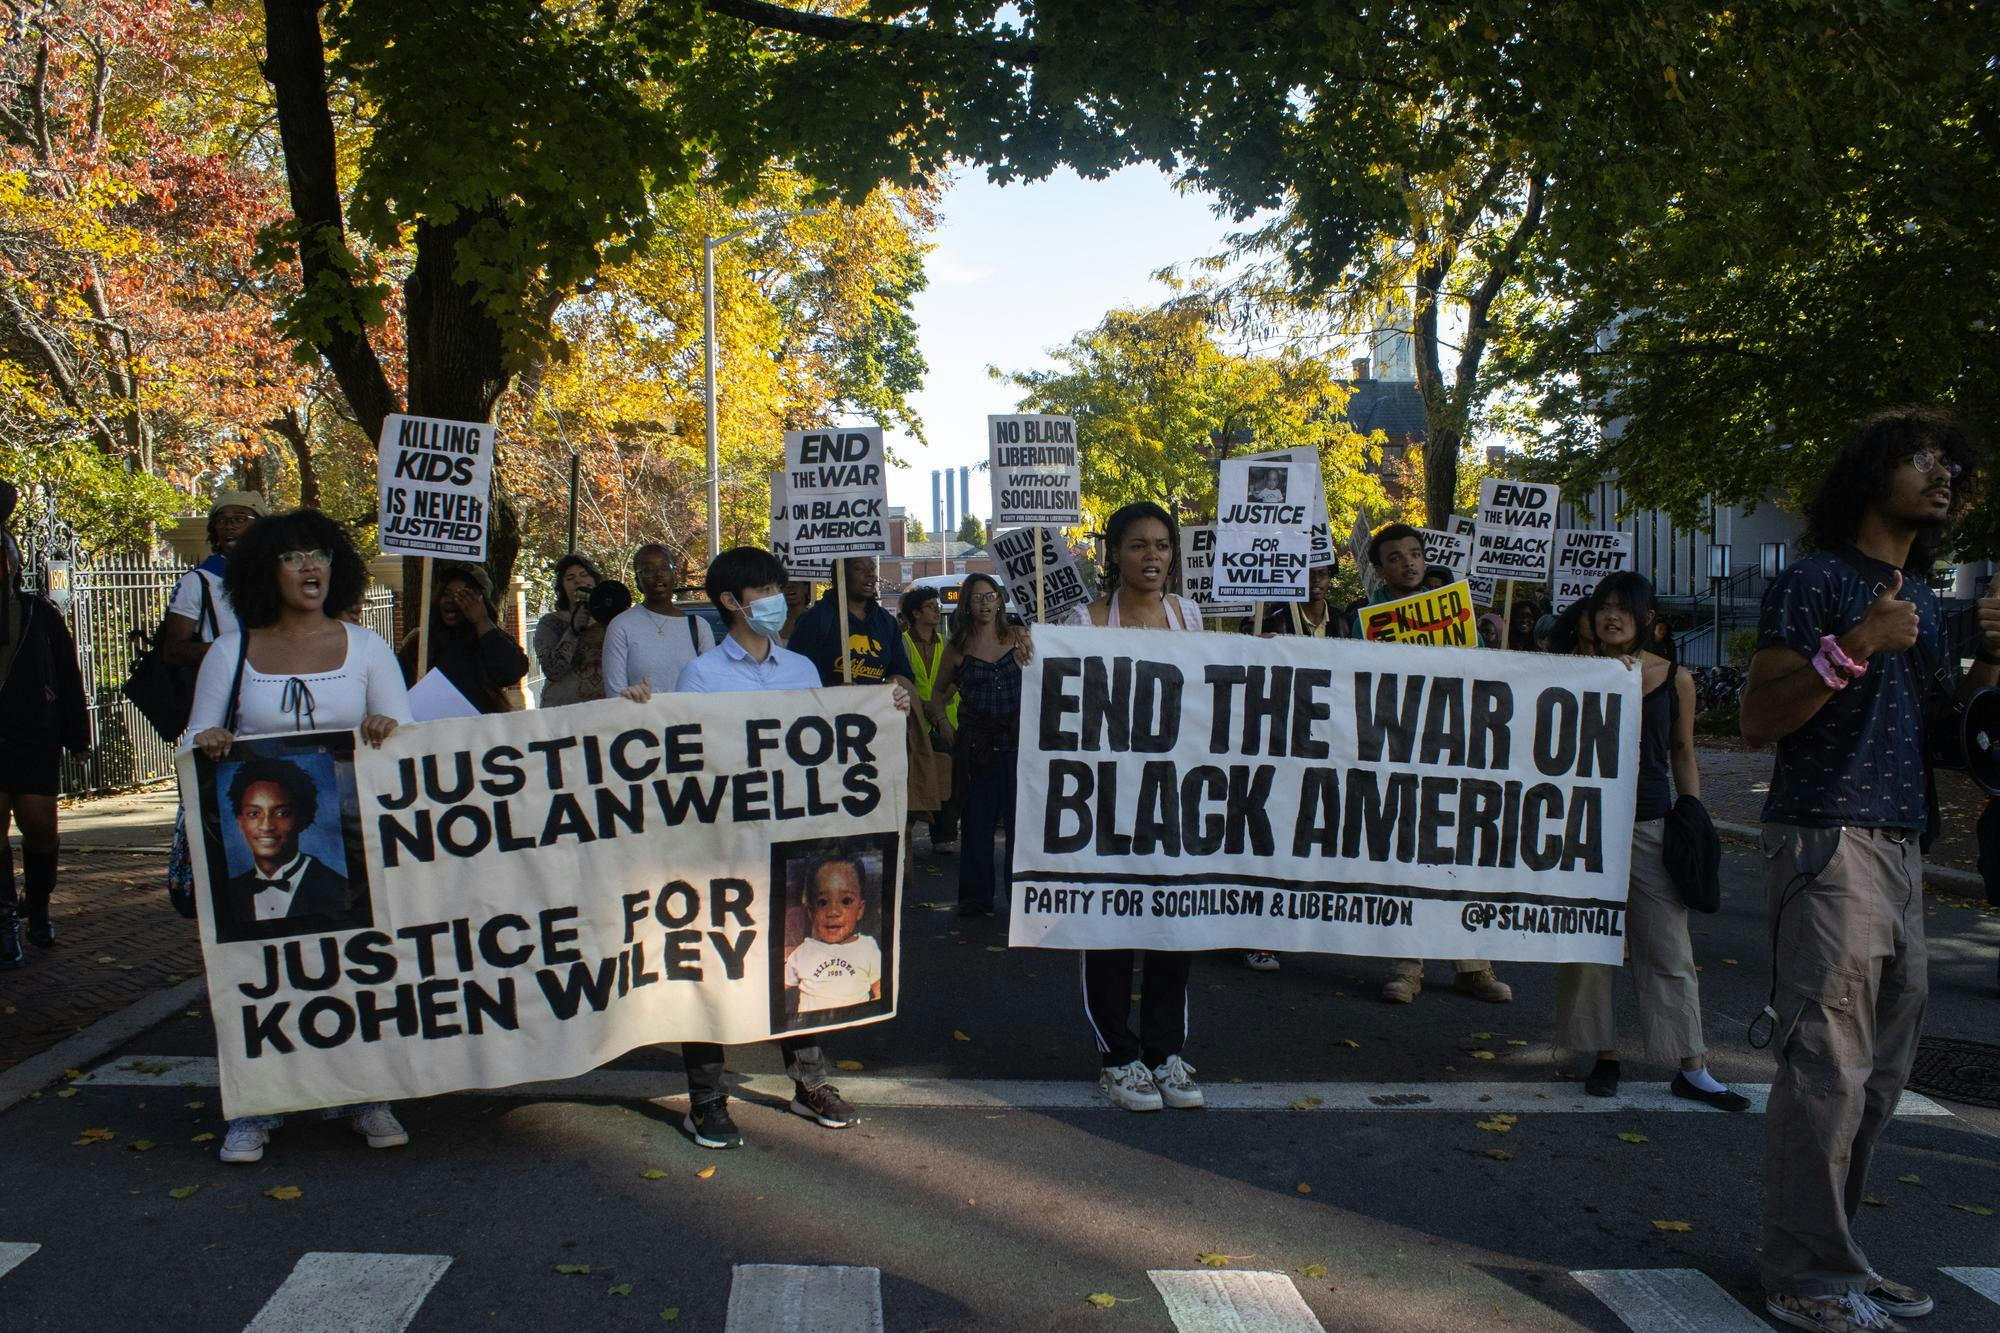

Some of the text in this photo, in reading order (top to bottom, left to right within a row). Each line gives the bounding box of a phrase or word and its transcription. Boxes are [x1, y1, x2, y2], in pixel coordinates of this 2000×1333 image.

[398, 420, 480, 455] KILLING
[996, 421, 1074, 444] NO BLACK
[800, 433, 870, 464] END
[997, 447, 1075, 467] LIBERATION
[394, 450, 475, 486] KIDS
[792, 464, 880, 488] THE WAR
[1009, 474, 1071, 487] WITHOUT
[387, 487, 482, 523] IS NEVER
[1001, 490, 1077, 509] SOCIALISM
[1492, 485, 1547, 509] END
[793, 504, 808, 520] ON
[811, 498, 883, 520] BLACK
[1221, 505, 1306, 524] JUSTICE
[1485, 509, 1552, 528] THE WAR
[385, 516, 482, 541] JUSTIFIED
[795, 520, 882, 540] AMERICA
[1192, 530, 1217, 551] EN
[1252, 538, 1280, 551] FOR
[1424, 532, 1456, 548] NITE
[1480, 536, 1550, 554] ON BLACK
[1567, 534, 1613, 548] UNITE
[1187, 556, 1204, 568] THE
[1222, 553, 1307, 567] KOHEN
[1424, 547, 1465, 567] GHT
[1479, 551, 1545, 568] AMERICA
[1560, 549, 1627, 569] FIGHT
[1187, 578, 1198, 589] ON
[1226, 569, 1302, 583] WILEY
[1011, 585, 1030, 605] IS
[1022, 584, 1083, 617] JUTIFIED
[1039, 656, 1622, 780] END THE WAR ON
[377, 714, 878, 811] JUSTICE FOR
[378, 762, 882, 869] NOLAN WELLS
[1044, 759, 1603, 874] BLACK AMERICA
[1025, 886, 1624, 937] PARTY FOR SOCIALISM & LIBERATION @PSLNATIONAL
[237, 879, 756, 1000] JUSTICE FOR
[813, 959, 856, 978] HILFIGER
[243, 929, 757, 1060] KOHEN WILEY
